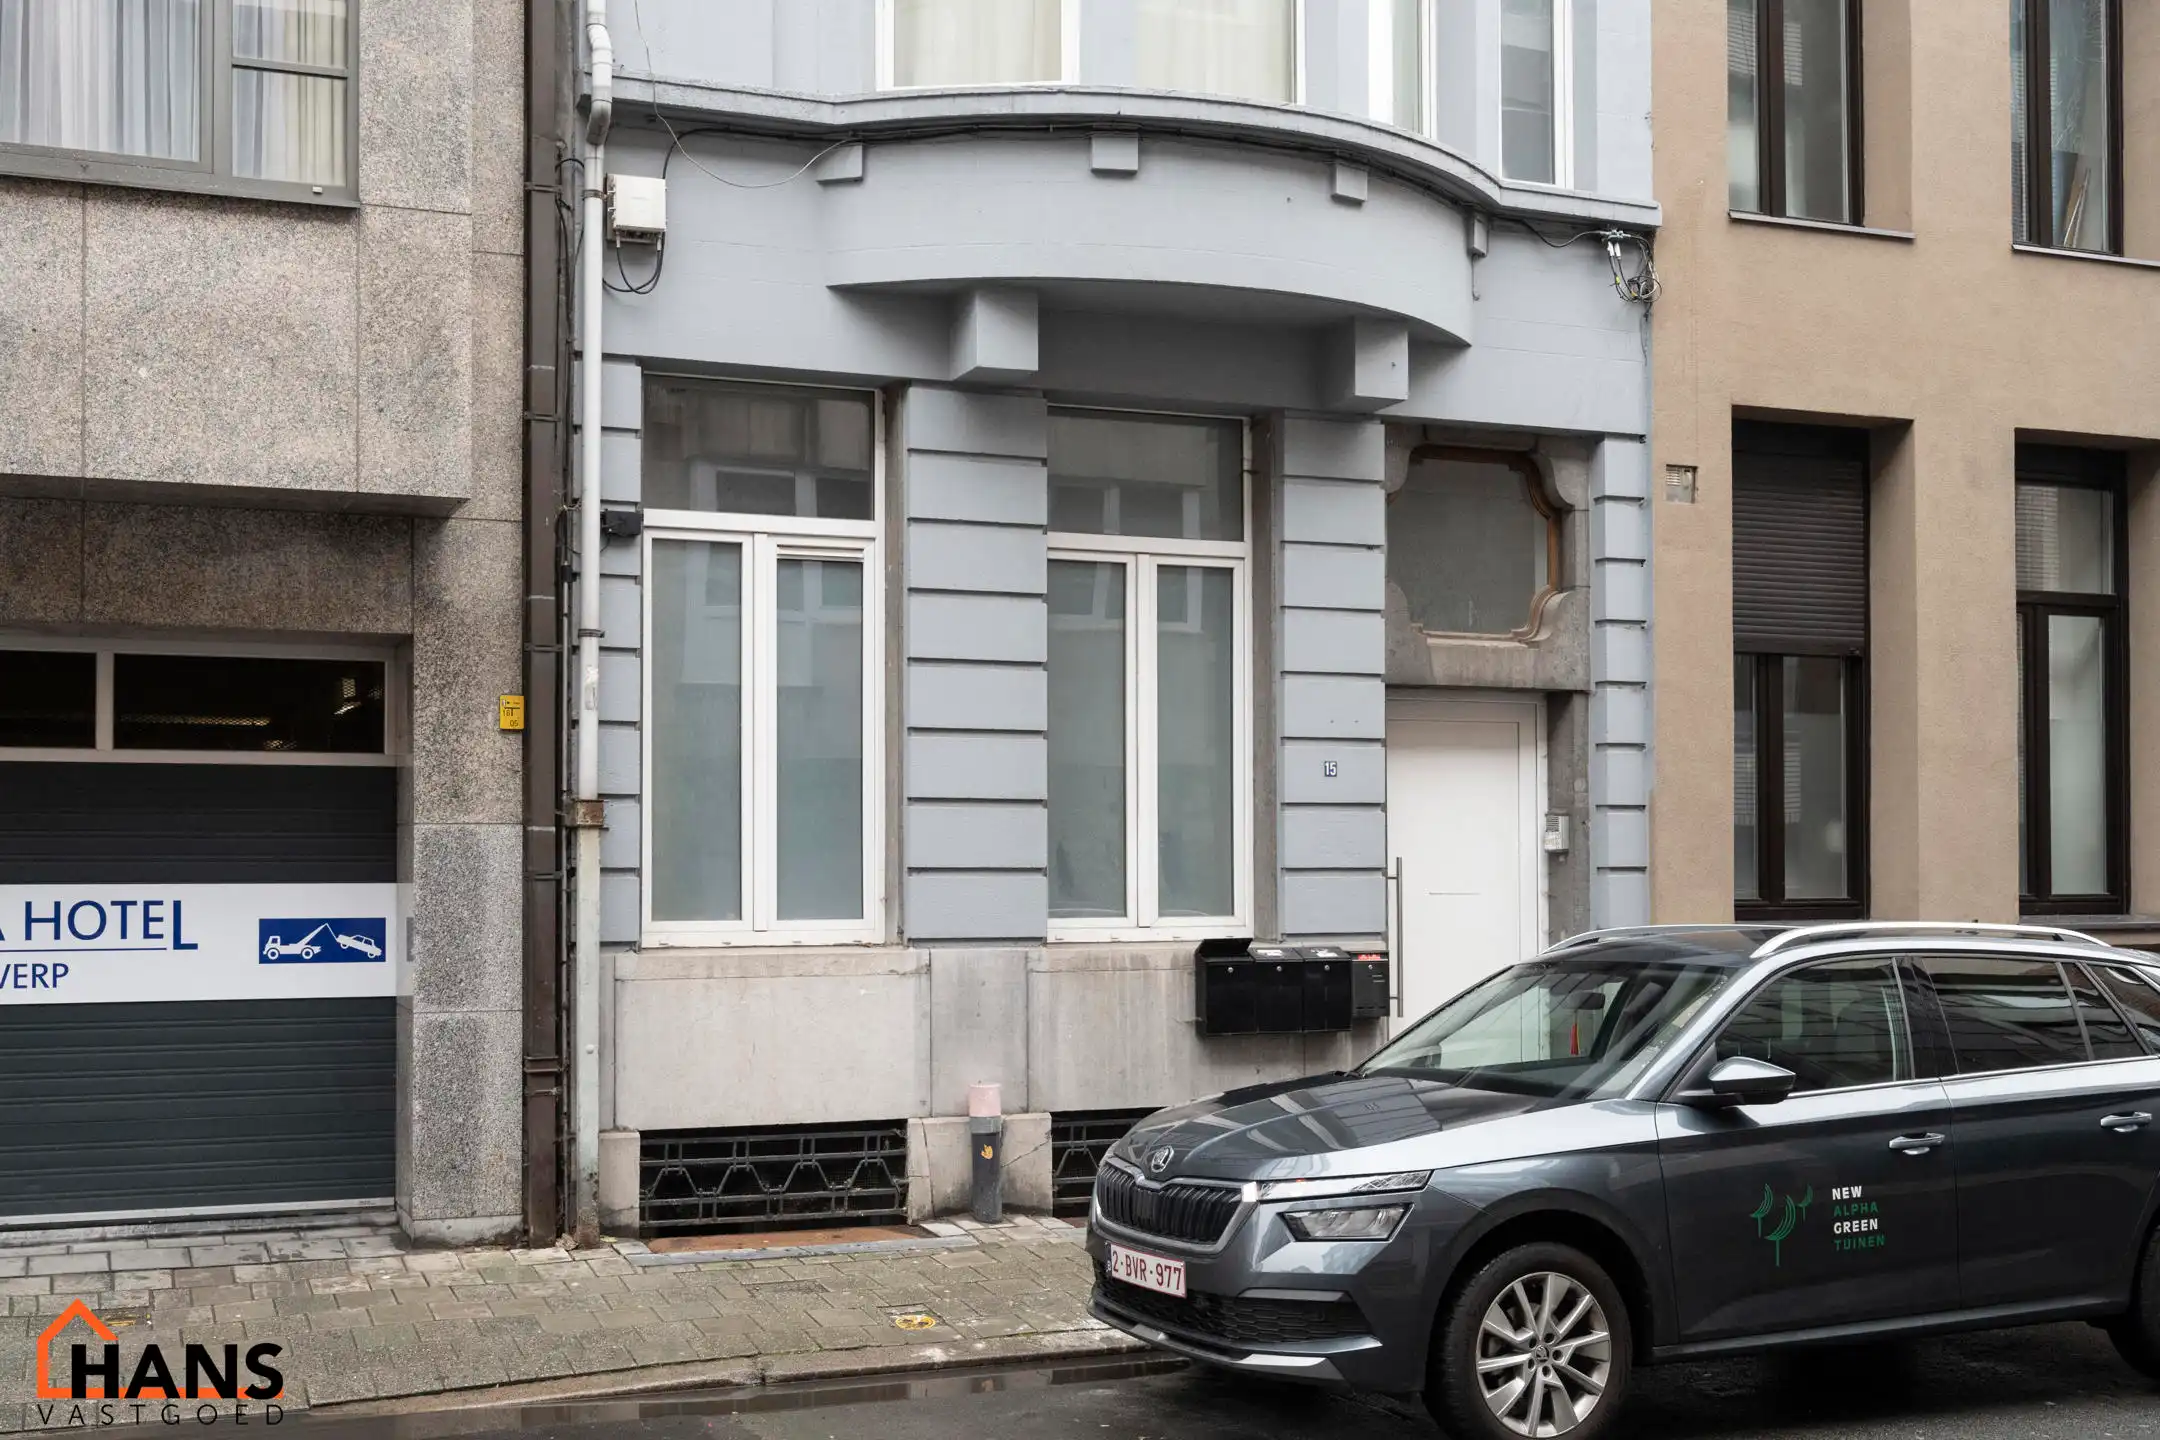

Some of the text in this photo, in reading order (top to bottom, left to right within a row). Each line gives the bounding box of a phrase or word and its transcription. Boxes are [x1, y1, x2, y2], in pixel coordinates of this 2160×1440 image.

[1325, 762, 1337, 776] 15
[25, 900, 198, 950] HOTEL
[1832, 1186, 1862, 1201] NEW
[1833, 1201, 1879, 1217] ALPHA
[1833, 1218, 1879, 1235] GREEN
[1834, 1235, 1886, 1251] TUINEN
